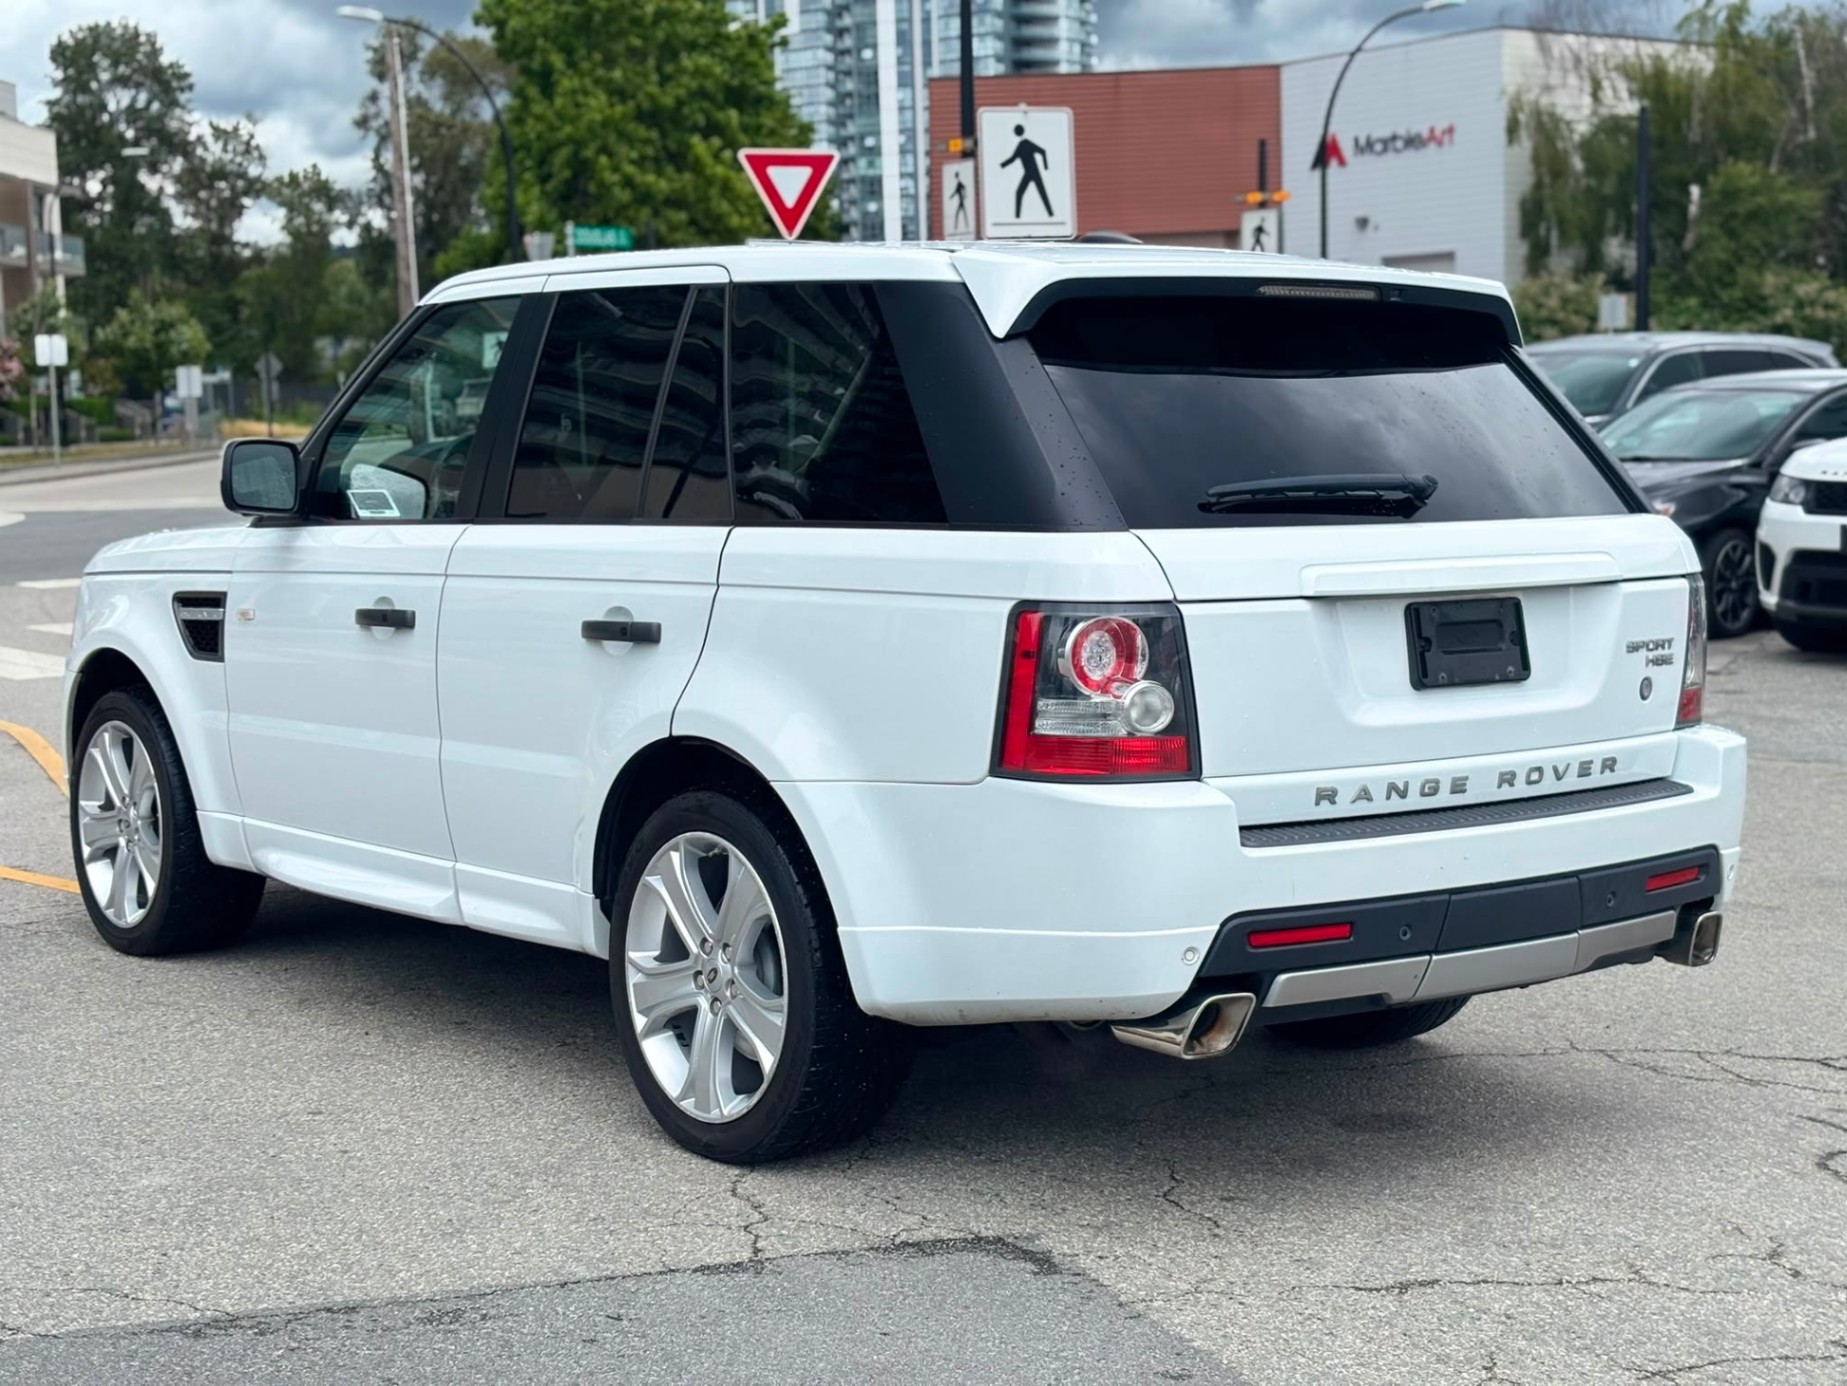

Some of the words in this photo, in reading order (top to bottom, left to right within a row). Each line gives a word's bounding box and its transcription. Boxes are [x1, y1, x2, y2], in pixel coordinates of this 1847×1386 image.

[1626, 638, 1674, 654] SPORT
[1645, 653, 1674, 667] HSE
[1314, 775, 1469, 806] RANGE
[1496, 756, 1618, 789] ROVER
